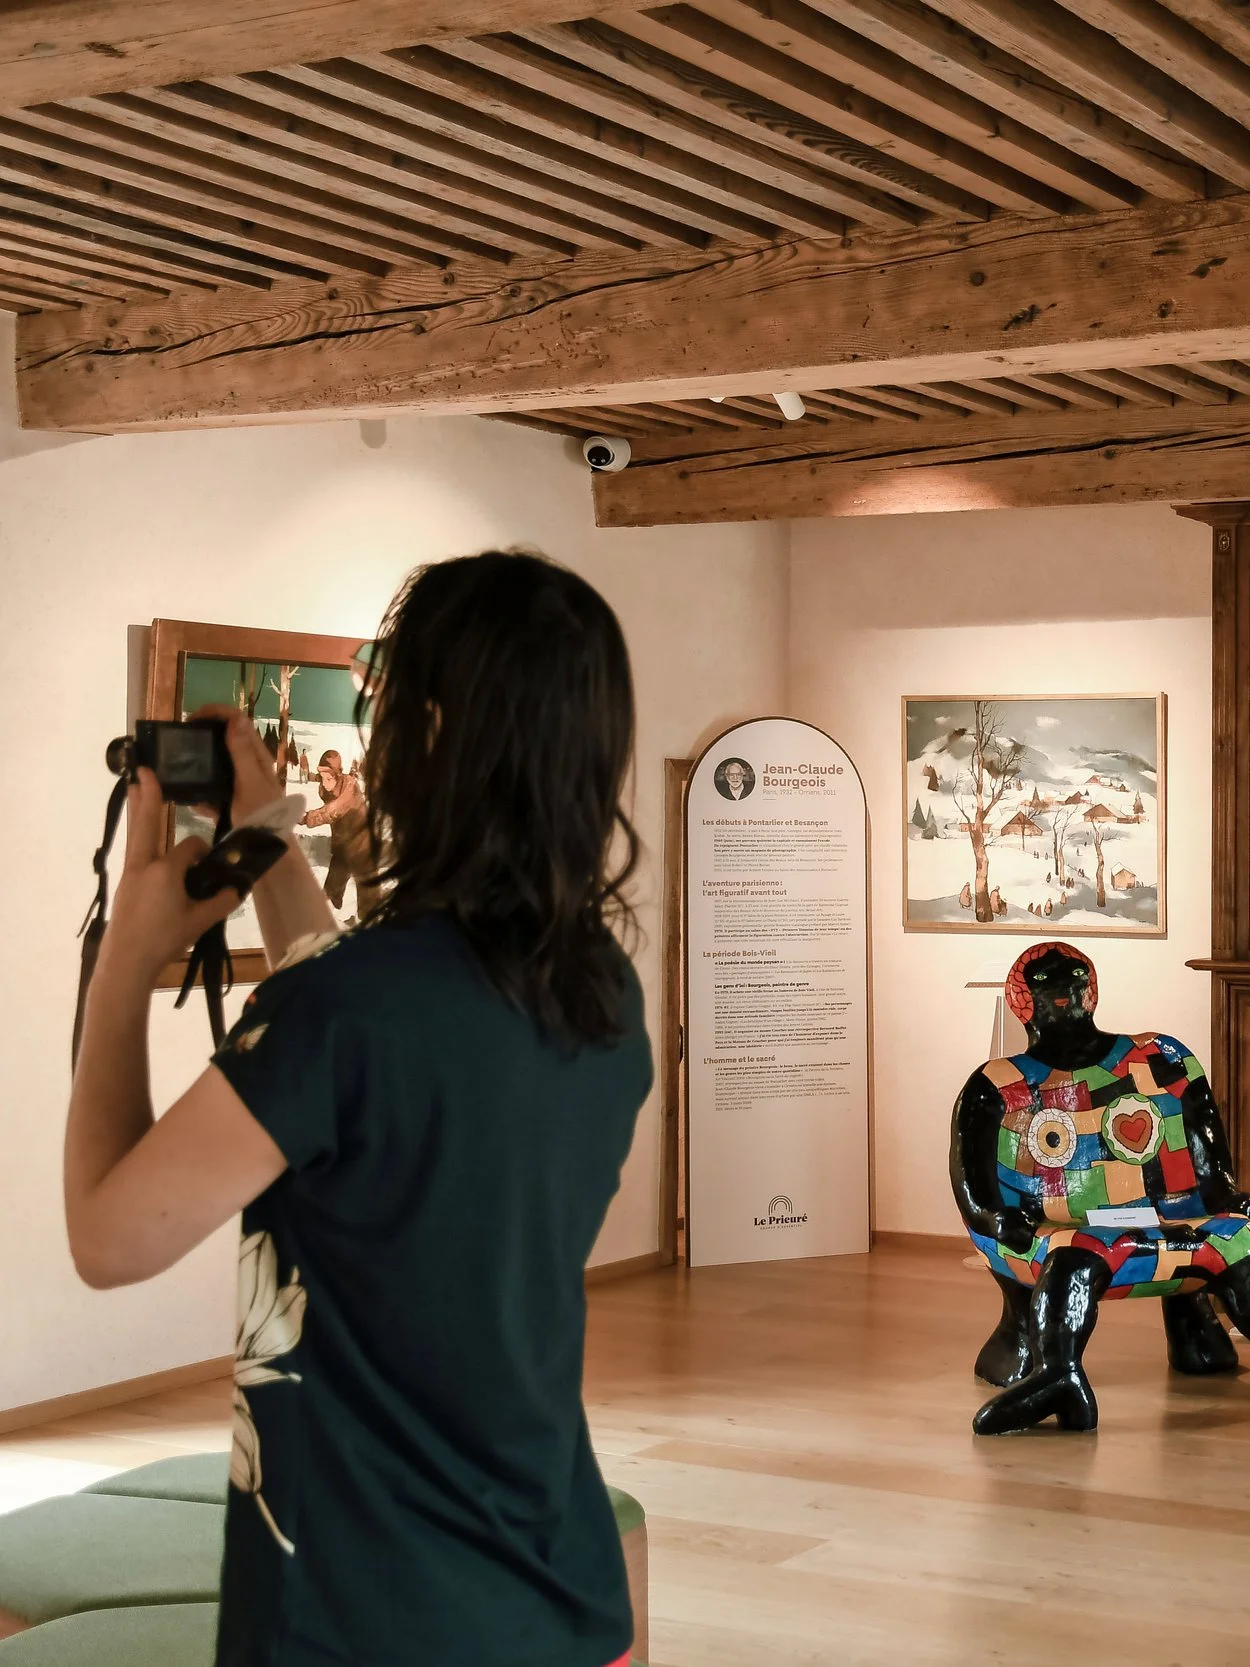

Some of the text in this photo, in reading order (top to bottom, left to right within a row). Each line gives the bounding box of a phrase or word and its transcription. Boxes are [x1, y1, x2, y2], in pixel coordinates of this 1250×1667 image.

[763, 764, 844, 775] Jean-Claude
[763, 776, 826, 789] Bourgeois
[794, 819, 828, 828] Besançon
[719, 889, 749, 898] figuratif
[712, 950, 741, 958] période
[742, 949, 777, 957] Bois-Vieil
[703, 1056, 737, 1064] L'homme
[754, 1213, 808, 1226] Le Prieuré
